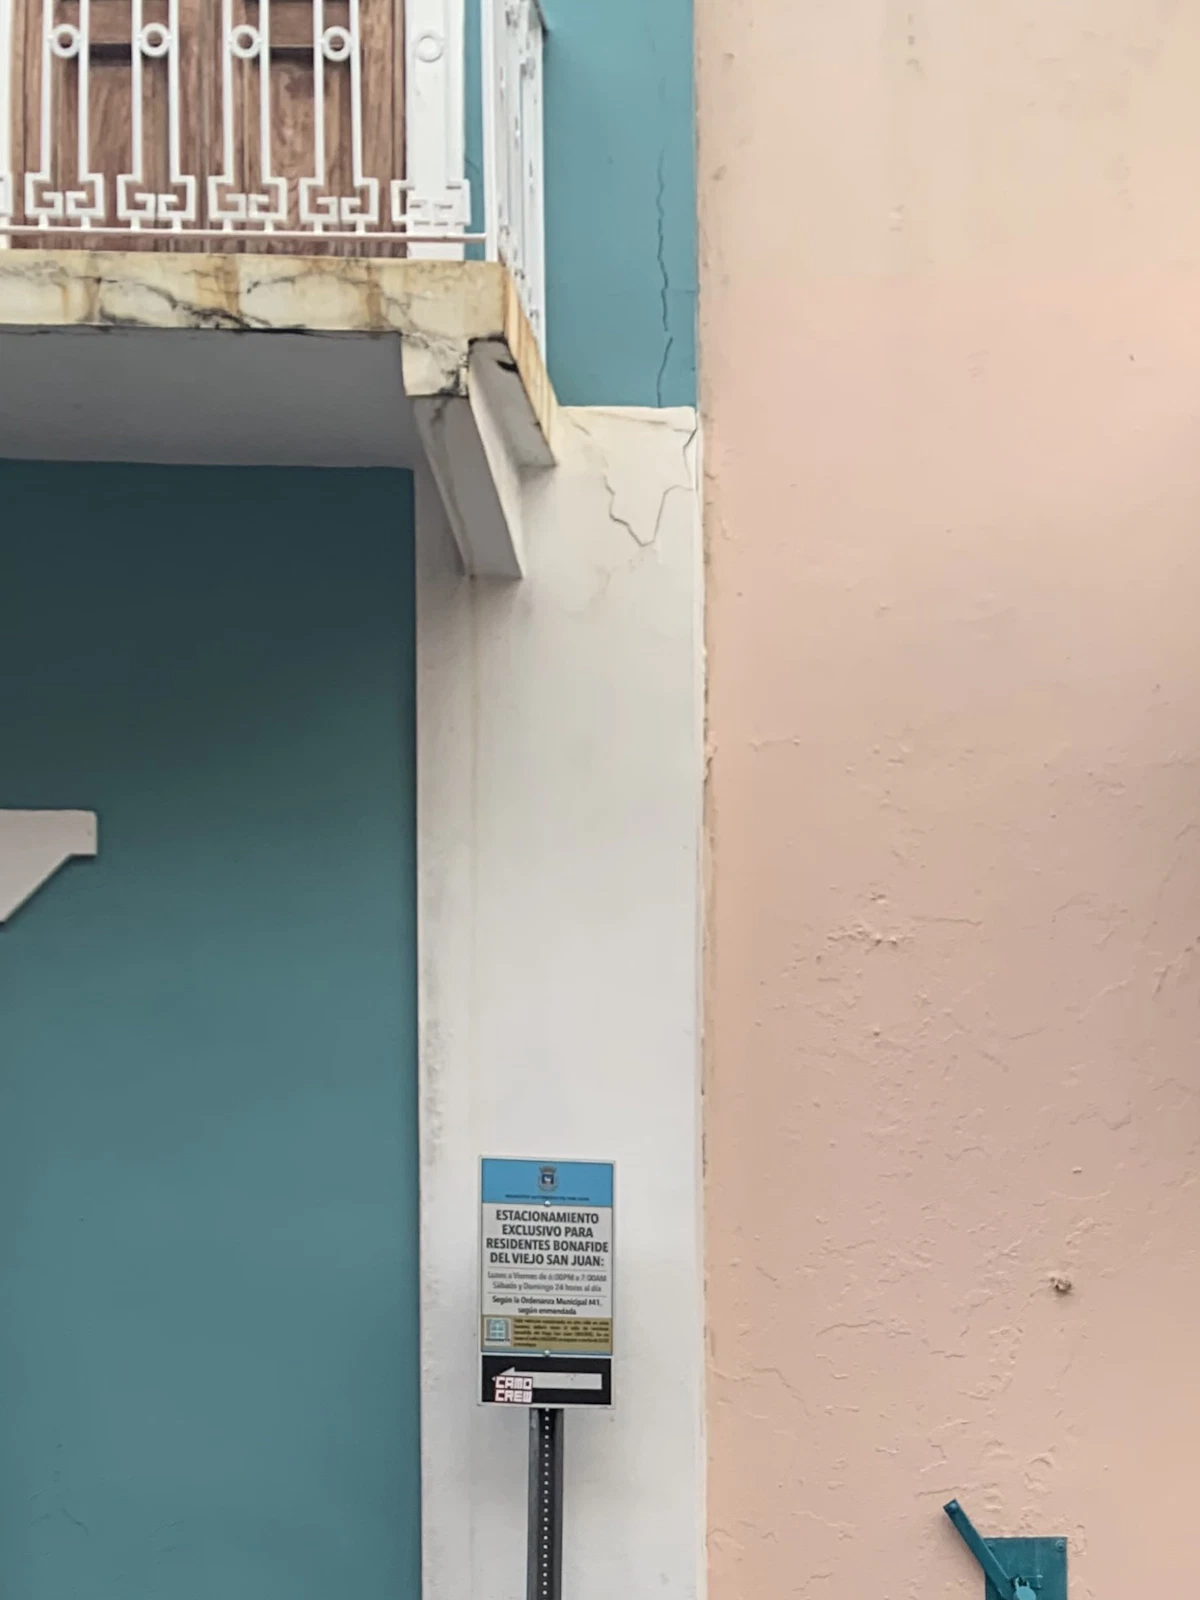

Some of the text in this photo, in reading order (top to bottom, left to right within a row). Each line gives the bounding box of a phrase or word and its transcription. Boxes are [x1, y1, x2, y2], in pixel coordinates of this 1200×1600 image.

[496, 1210, 599, 1224] ESTACIONAMIENTO
[502, 1224, 593, 1238] EXCLUSIVO PARA
[486, 1238, 608, 1252] RESIDENTES BONAFIDE
[490, 1252, 604, 1266] DEL VIEJO SAN JUAN:
[523, 1282, 553, 1292] Domingo
[520, 1296, 555, 1304] Ordenanza
[556, 1298, 587, 1306] Municipal
[495, 1376, 532, 1390] CAMO
[494, 1390, 532, 1403] CREW
